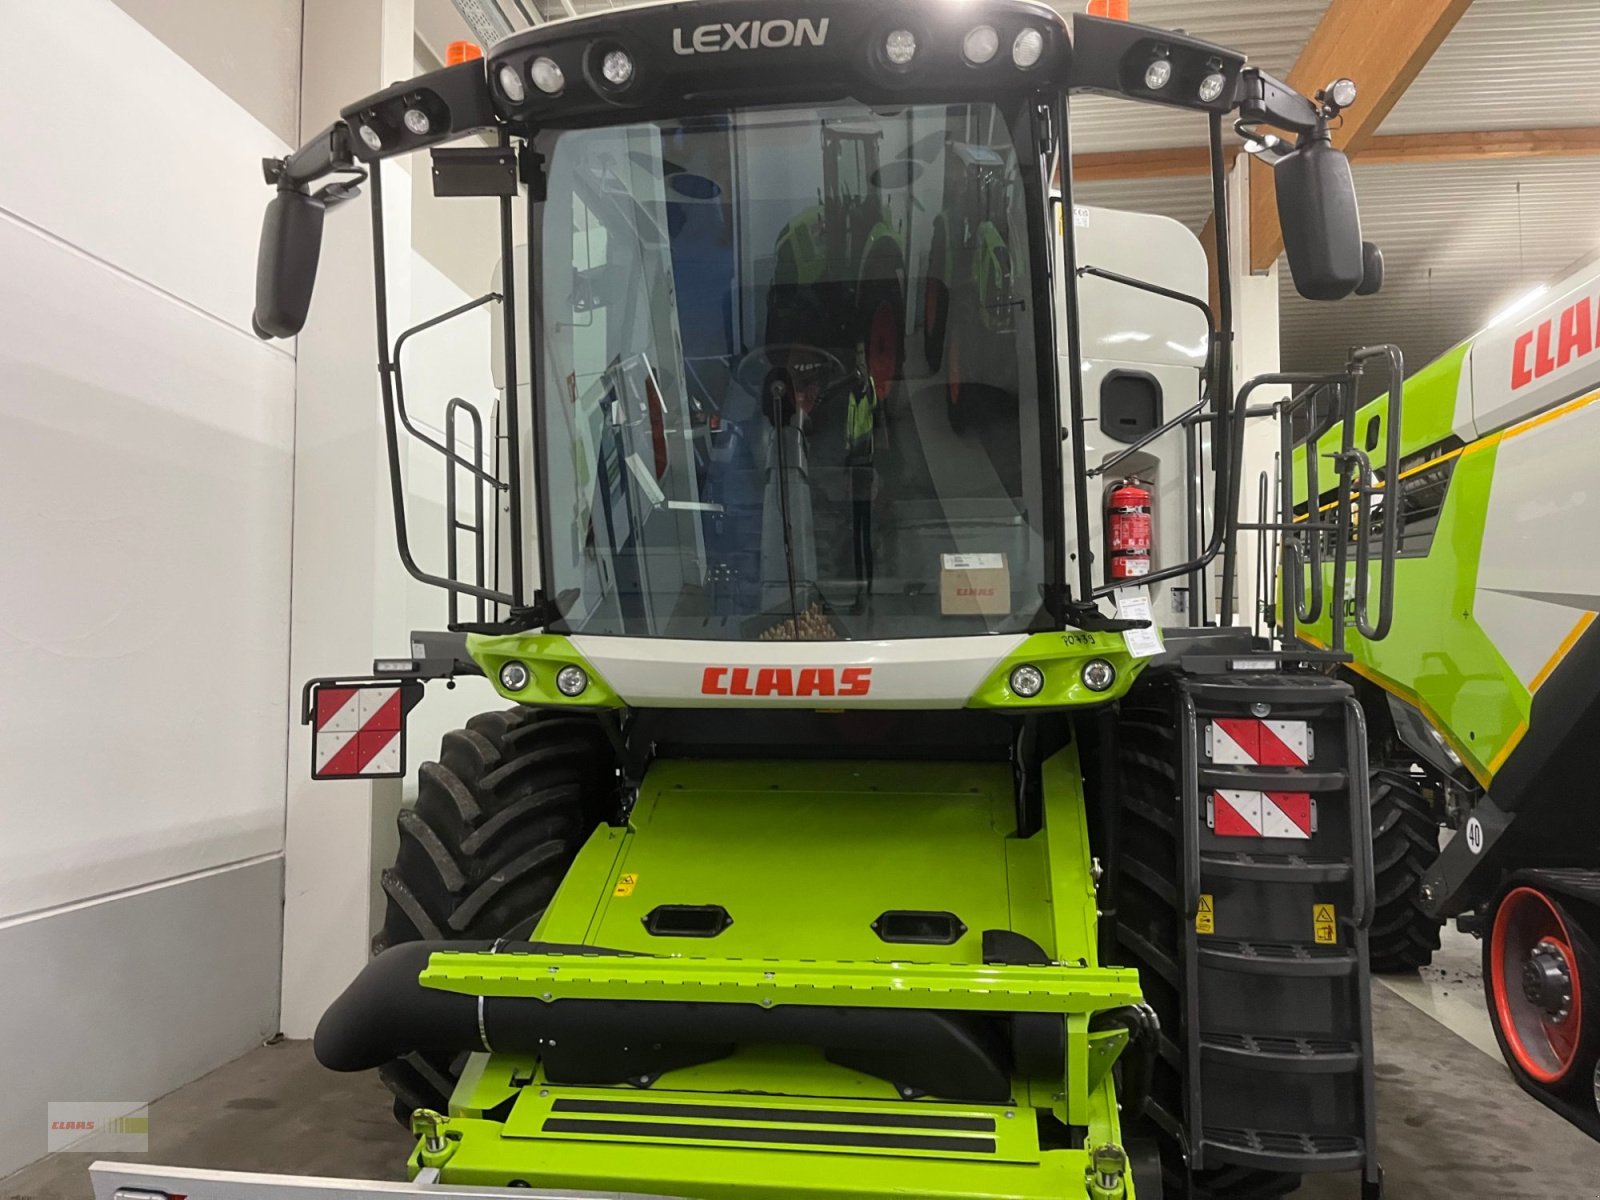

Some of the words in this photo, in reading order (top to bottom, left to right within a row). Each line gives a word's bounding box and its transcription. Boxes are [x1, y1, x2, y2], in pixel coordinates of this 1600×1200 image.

[672, 18, 830, 55] LEXION
[1511, 295, 1600, 391] CLA
[701, 667, 873, 696] CLAAS
[1469, 823, 1481, 847] 40
